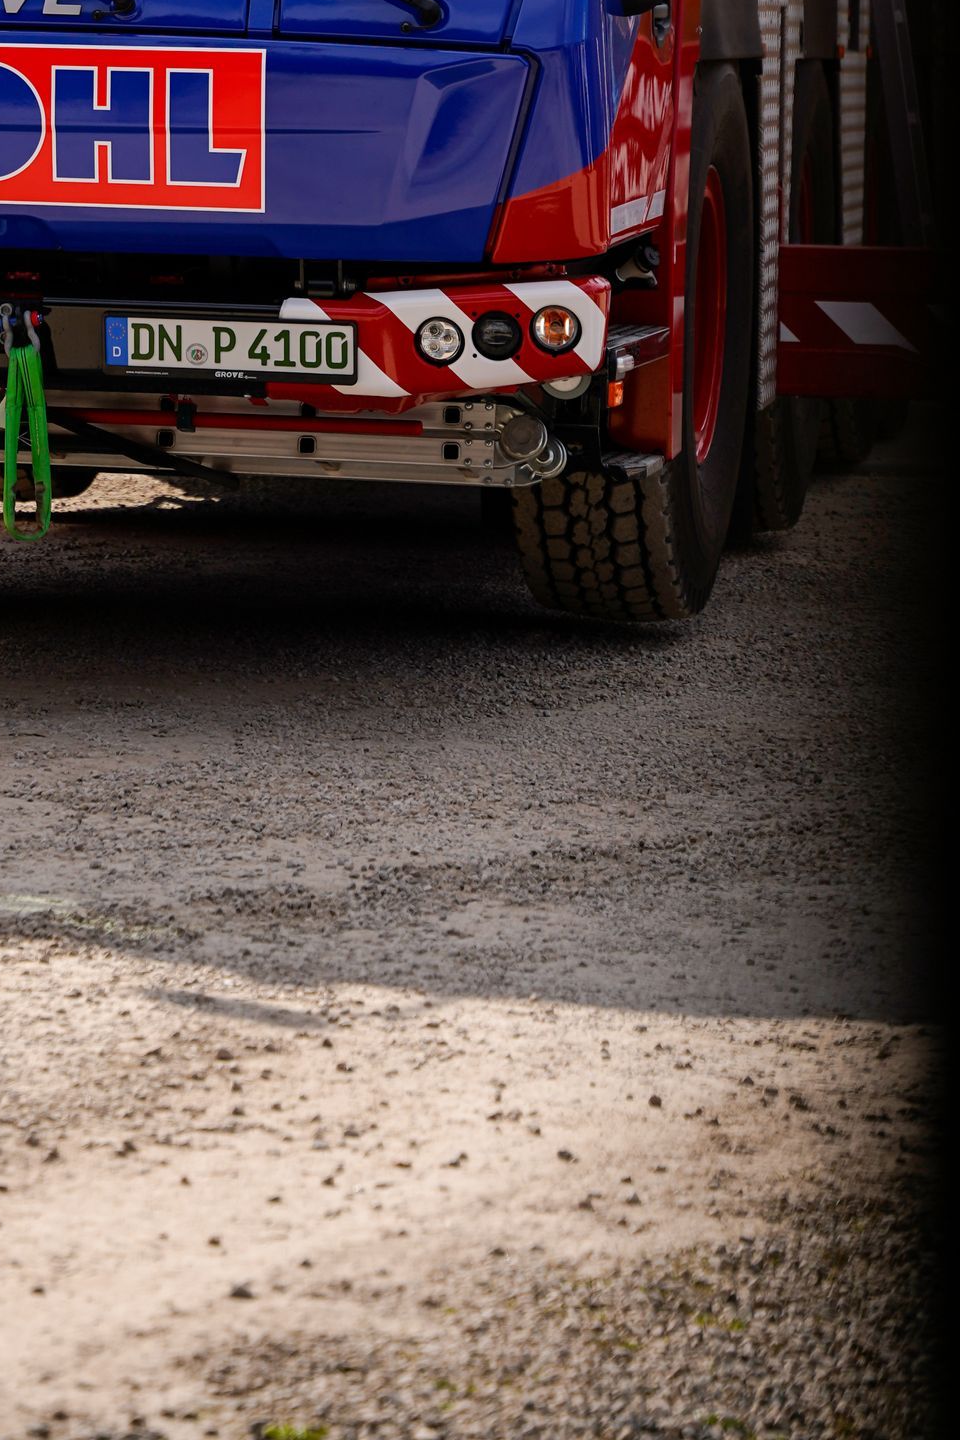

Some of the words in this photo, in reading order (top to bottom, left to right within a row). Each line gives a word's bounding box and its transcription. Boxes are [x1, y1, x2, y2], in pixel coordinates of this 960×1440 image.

[112, 346, 122, 358] D
[131, 323, 182, 362] DN
[212, 326, 237, 364] P
[248, 328, 348, 370] 4100
[215, 370, 245, 379] GROVE
